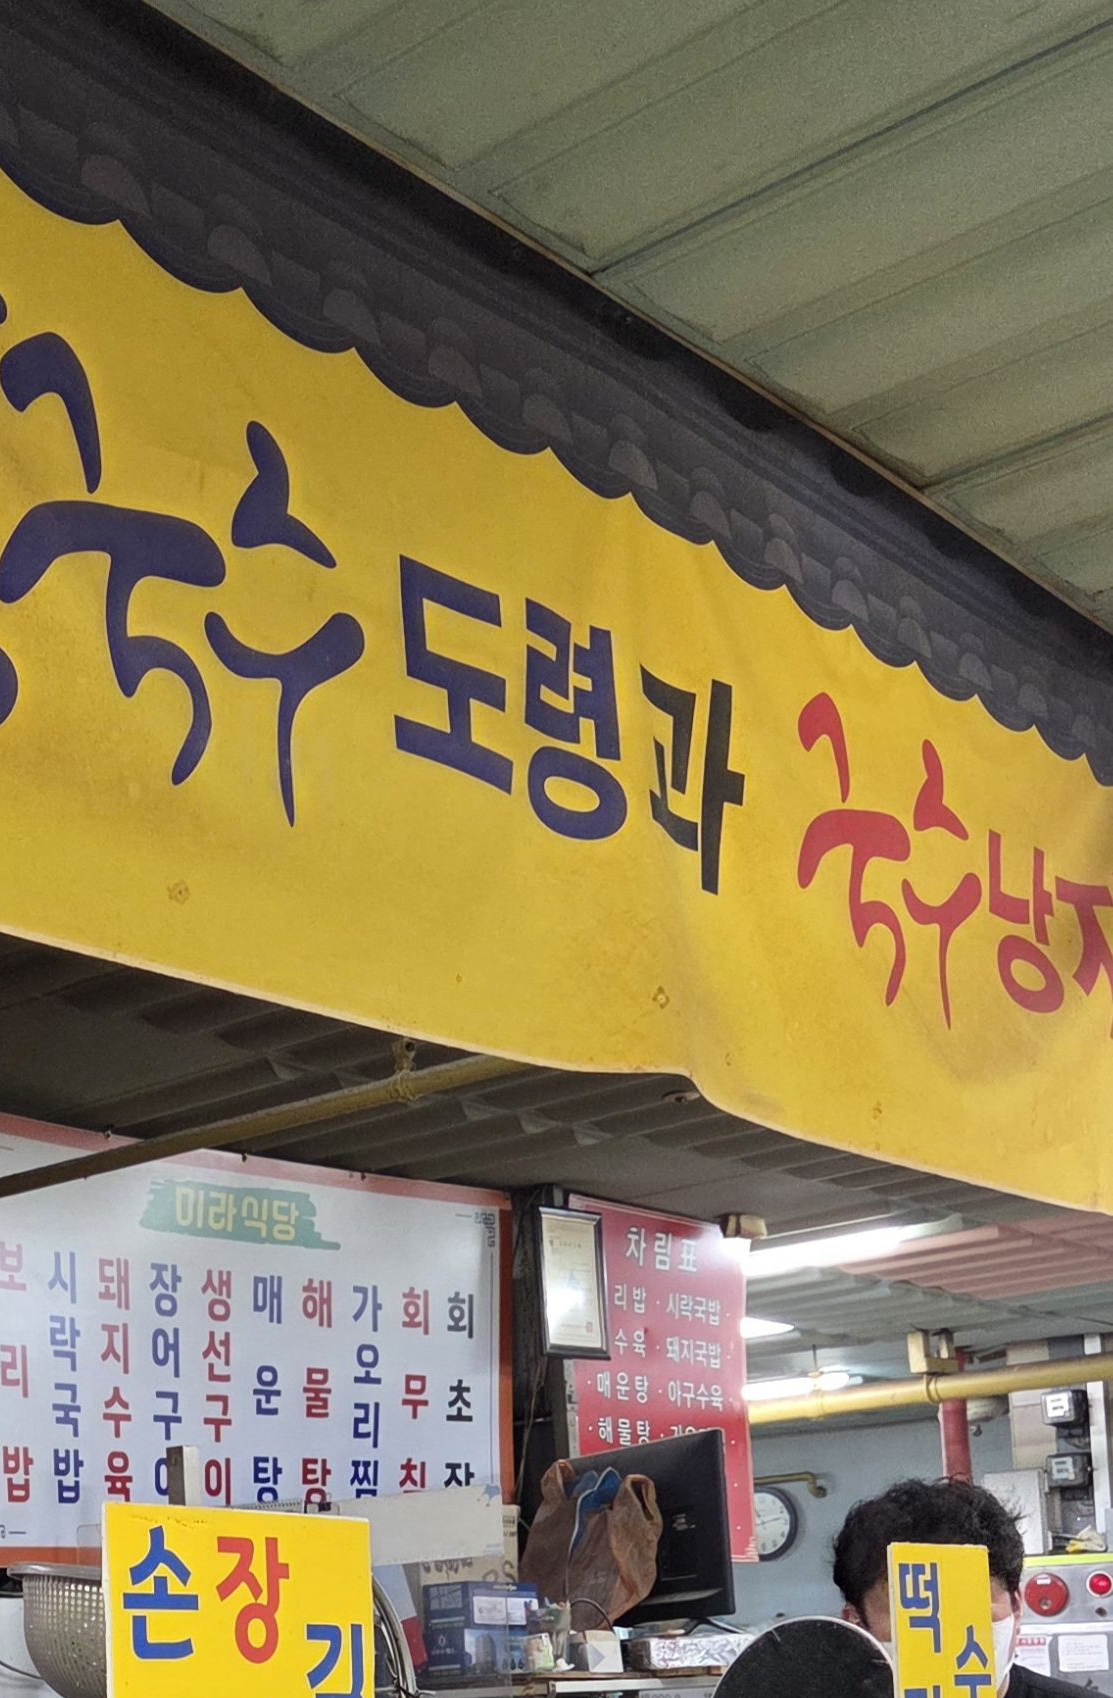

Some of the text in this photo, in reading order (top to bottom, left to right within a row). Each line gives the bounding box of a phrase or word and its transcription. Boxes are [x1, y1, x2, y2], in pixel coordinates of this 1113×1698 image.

[394, 554, 745, 895] 도령과
[626, 1227, 698, 1273] 차림표
[666, 1293, 721, 1326] 시락국밥
[47, 1250, 84, 1504] 시락국밥
[98, 1257, 133, 1504] 돼지수육
[200, 1267, 233, 1505] 생선구이
[666, 1336, 721, 1369] 돼지국밥
[667, 1379, 724, 1412] 아구수육
